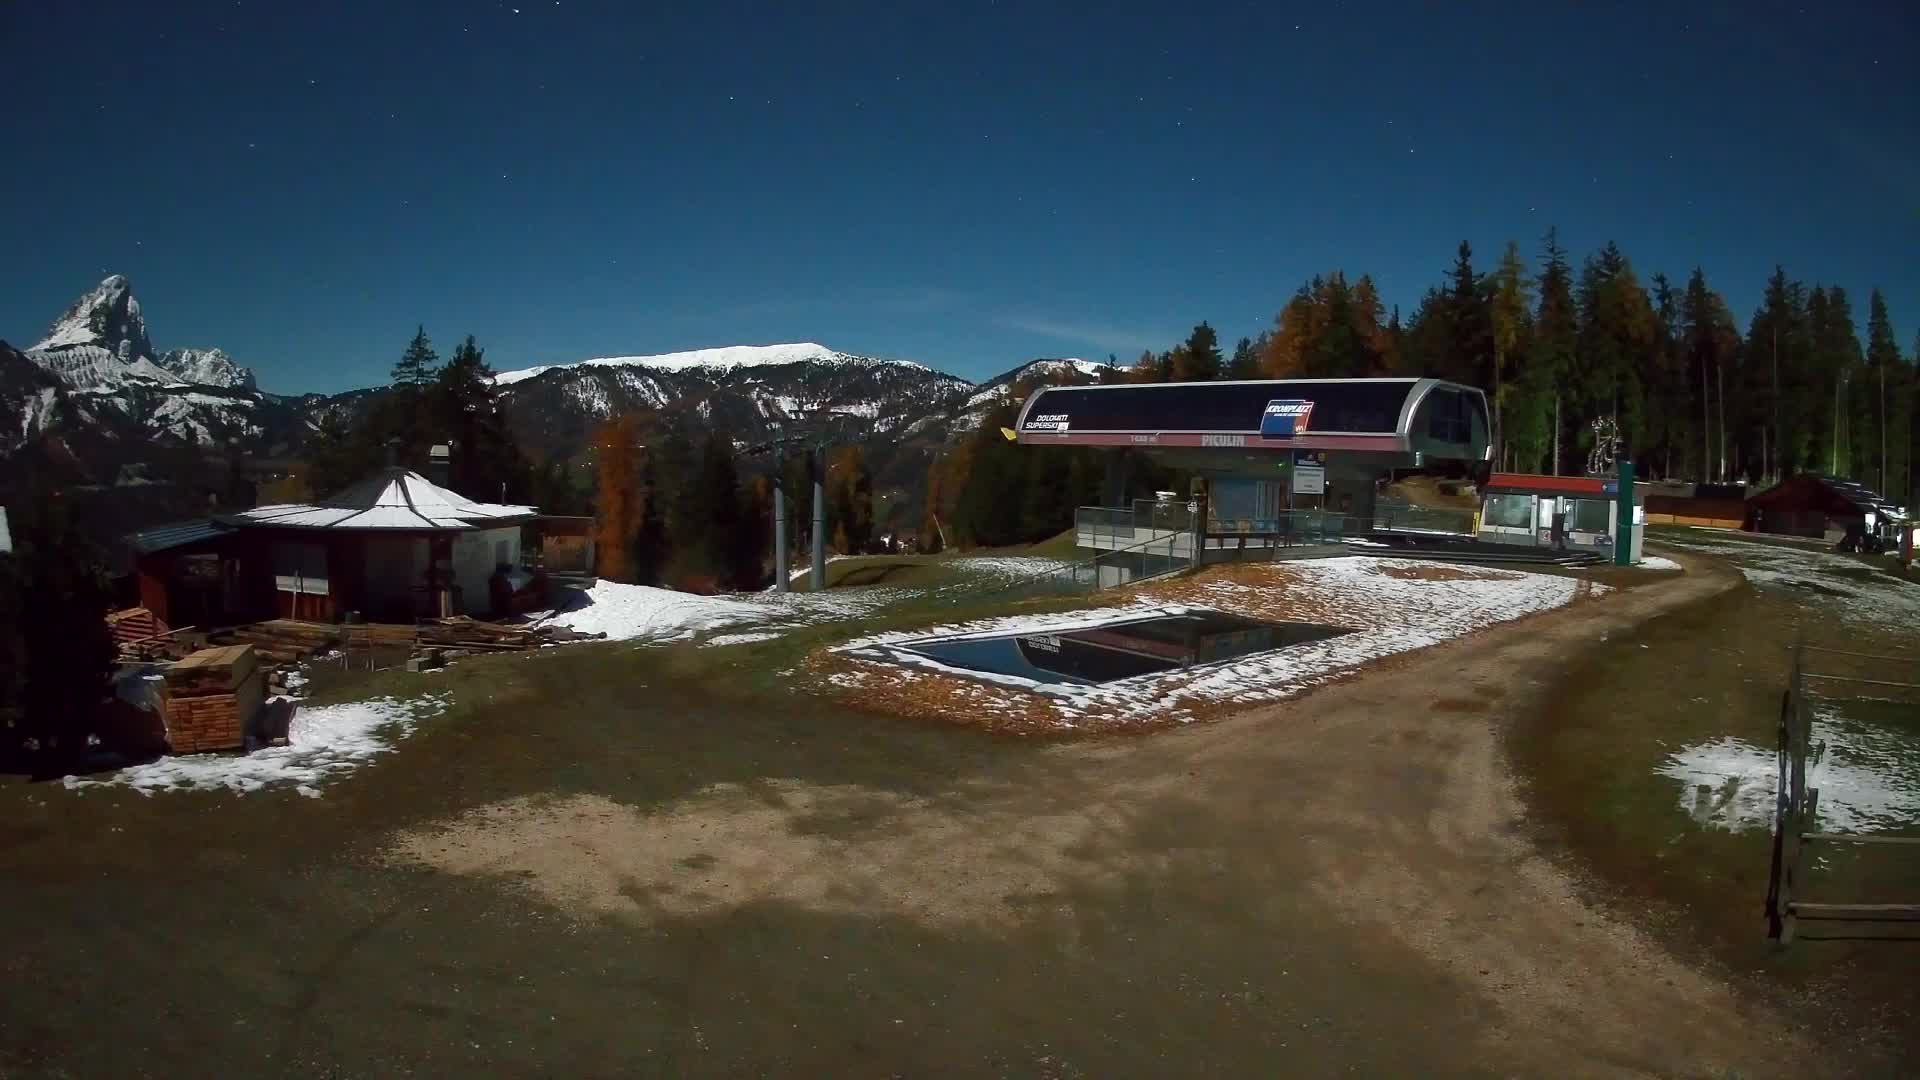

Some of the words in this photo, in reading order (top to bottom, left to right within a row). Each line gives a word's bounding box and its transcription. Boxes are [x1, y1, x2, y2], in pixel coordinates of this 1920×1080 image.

[1266, 404, 1311, 413] KRONPLATZ
[1036, 414, 1069, 422] DOLOMITI
[1025, 421, 1058, 429] SUPERSKI
[1201, 434, 1245, 447] PICULIN
